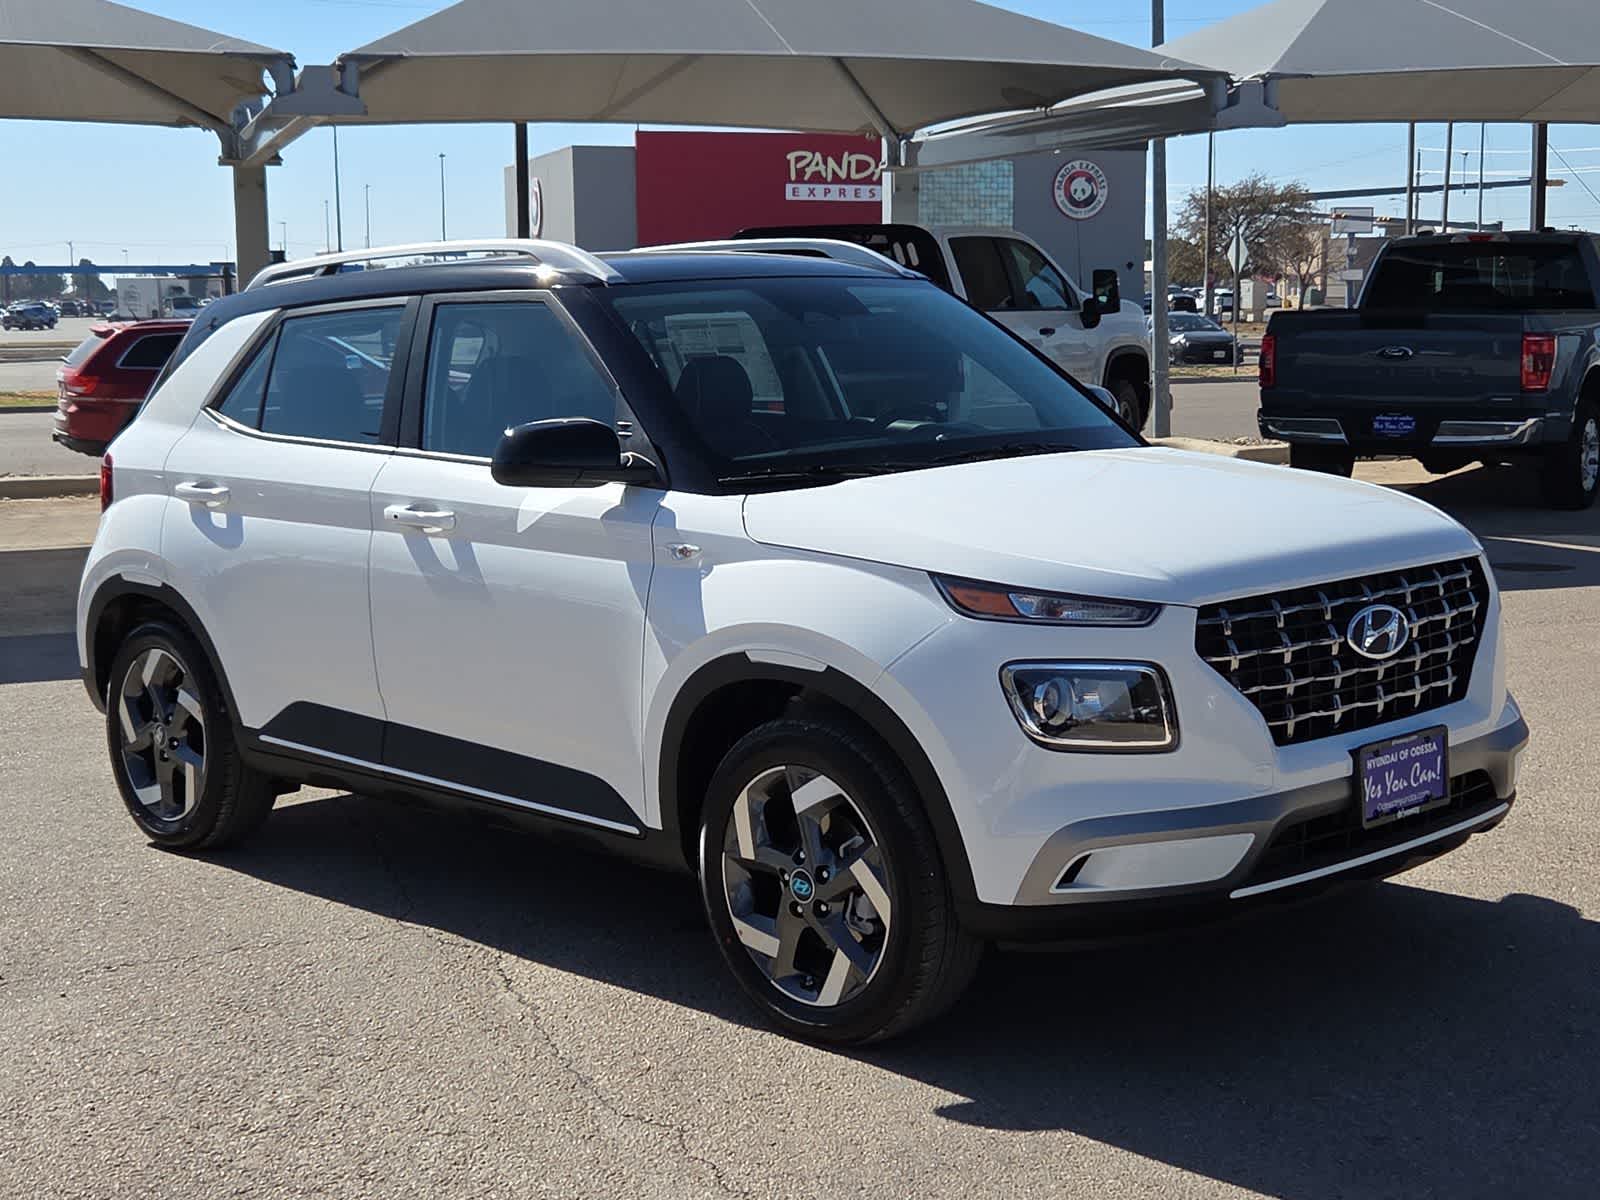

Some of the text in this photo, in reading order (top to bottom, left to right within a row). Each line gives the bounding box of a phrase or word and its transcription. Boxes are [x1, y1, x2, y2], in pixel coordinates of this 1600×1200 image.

[792, 187, 877, 198] EXPRES
[1366, 741, 1438, 770] HYUNDAI OF ODESSA
[1364, 775, 1382, 802] Yes
[1384, 769, 1408, 795] You
[1410, 755, 1442, 788] Can!
